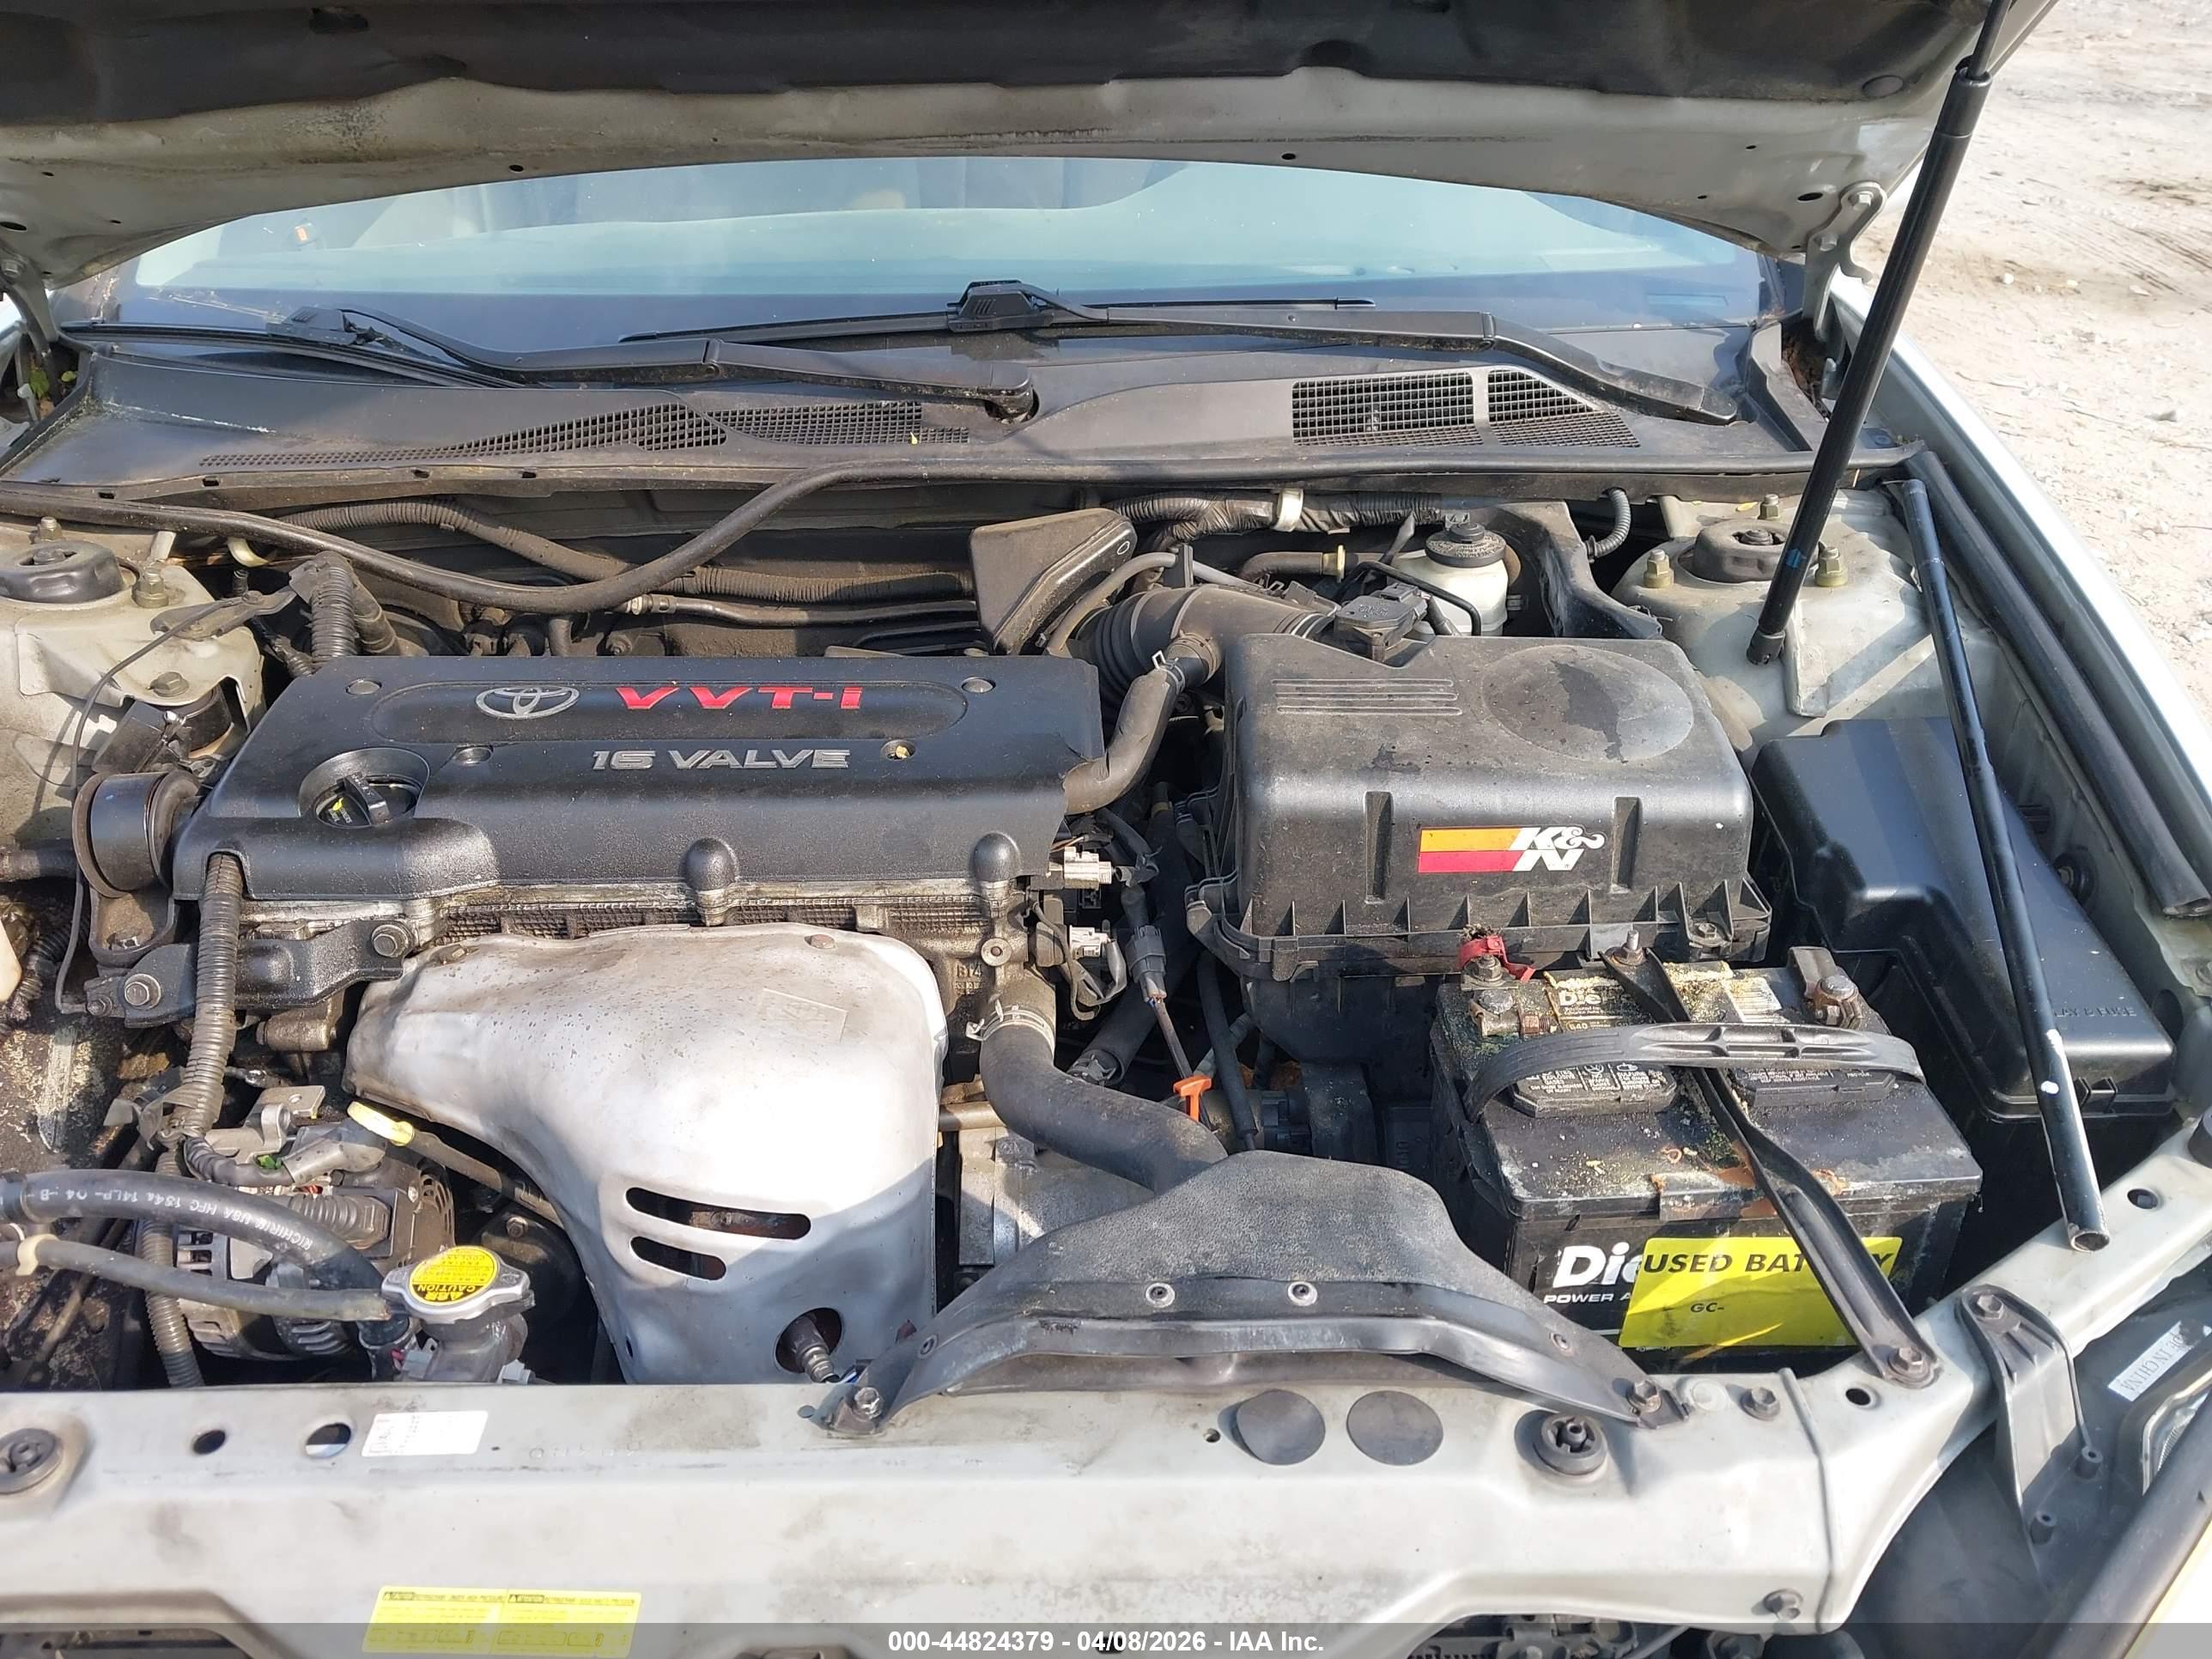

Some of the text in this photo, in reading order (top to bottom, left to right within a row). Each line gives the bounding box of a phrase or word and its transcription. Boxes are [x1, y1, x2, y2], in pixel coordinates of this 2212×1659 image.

[592, 750, 852, 770] 16 VALVE
[2053, 1007, 2079, 1018] LAY
[188, 1199, 217, 1215] HFC
[223, 1206, 252, 1226] USA
[1644, 1253, 1895, 1273] USED BATY
[417, 1284, 476, 1293] CAUTION
[1543, 1293, 1614, 1304] POWER
[2120, 1360, 2160, 1391] CHINA
